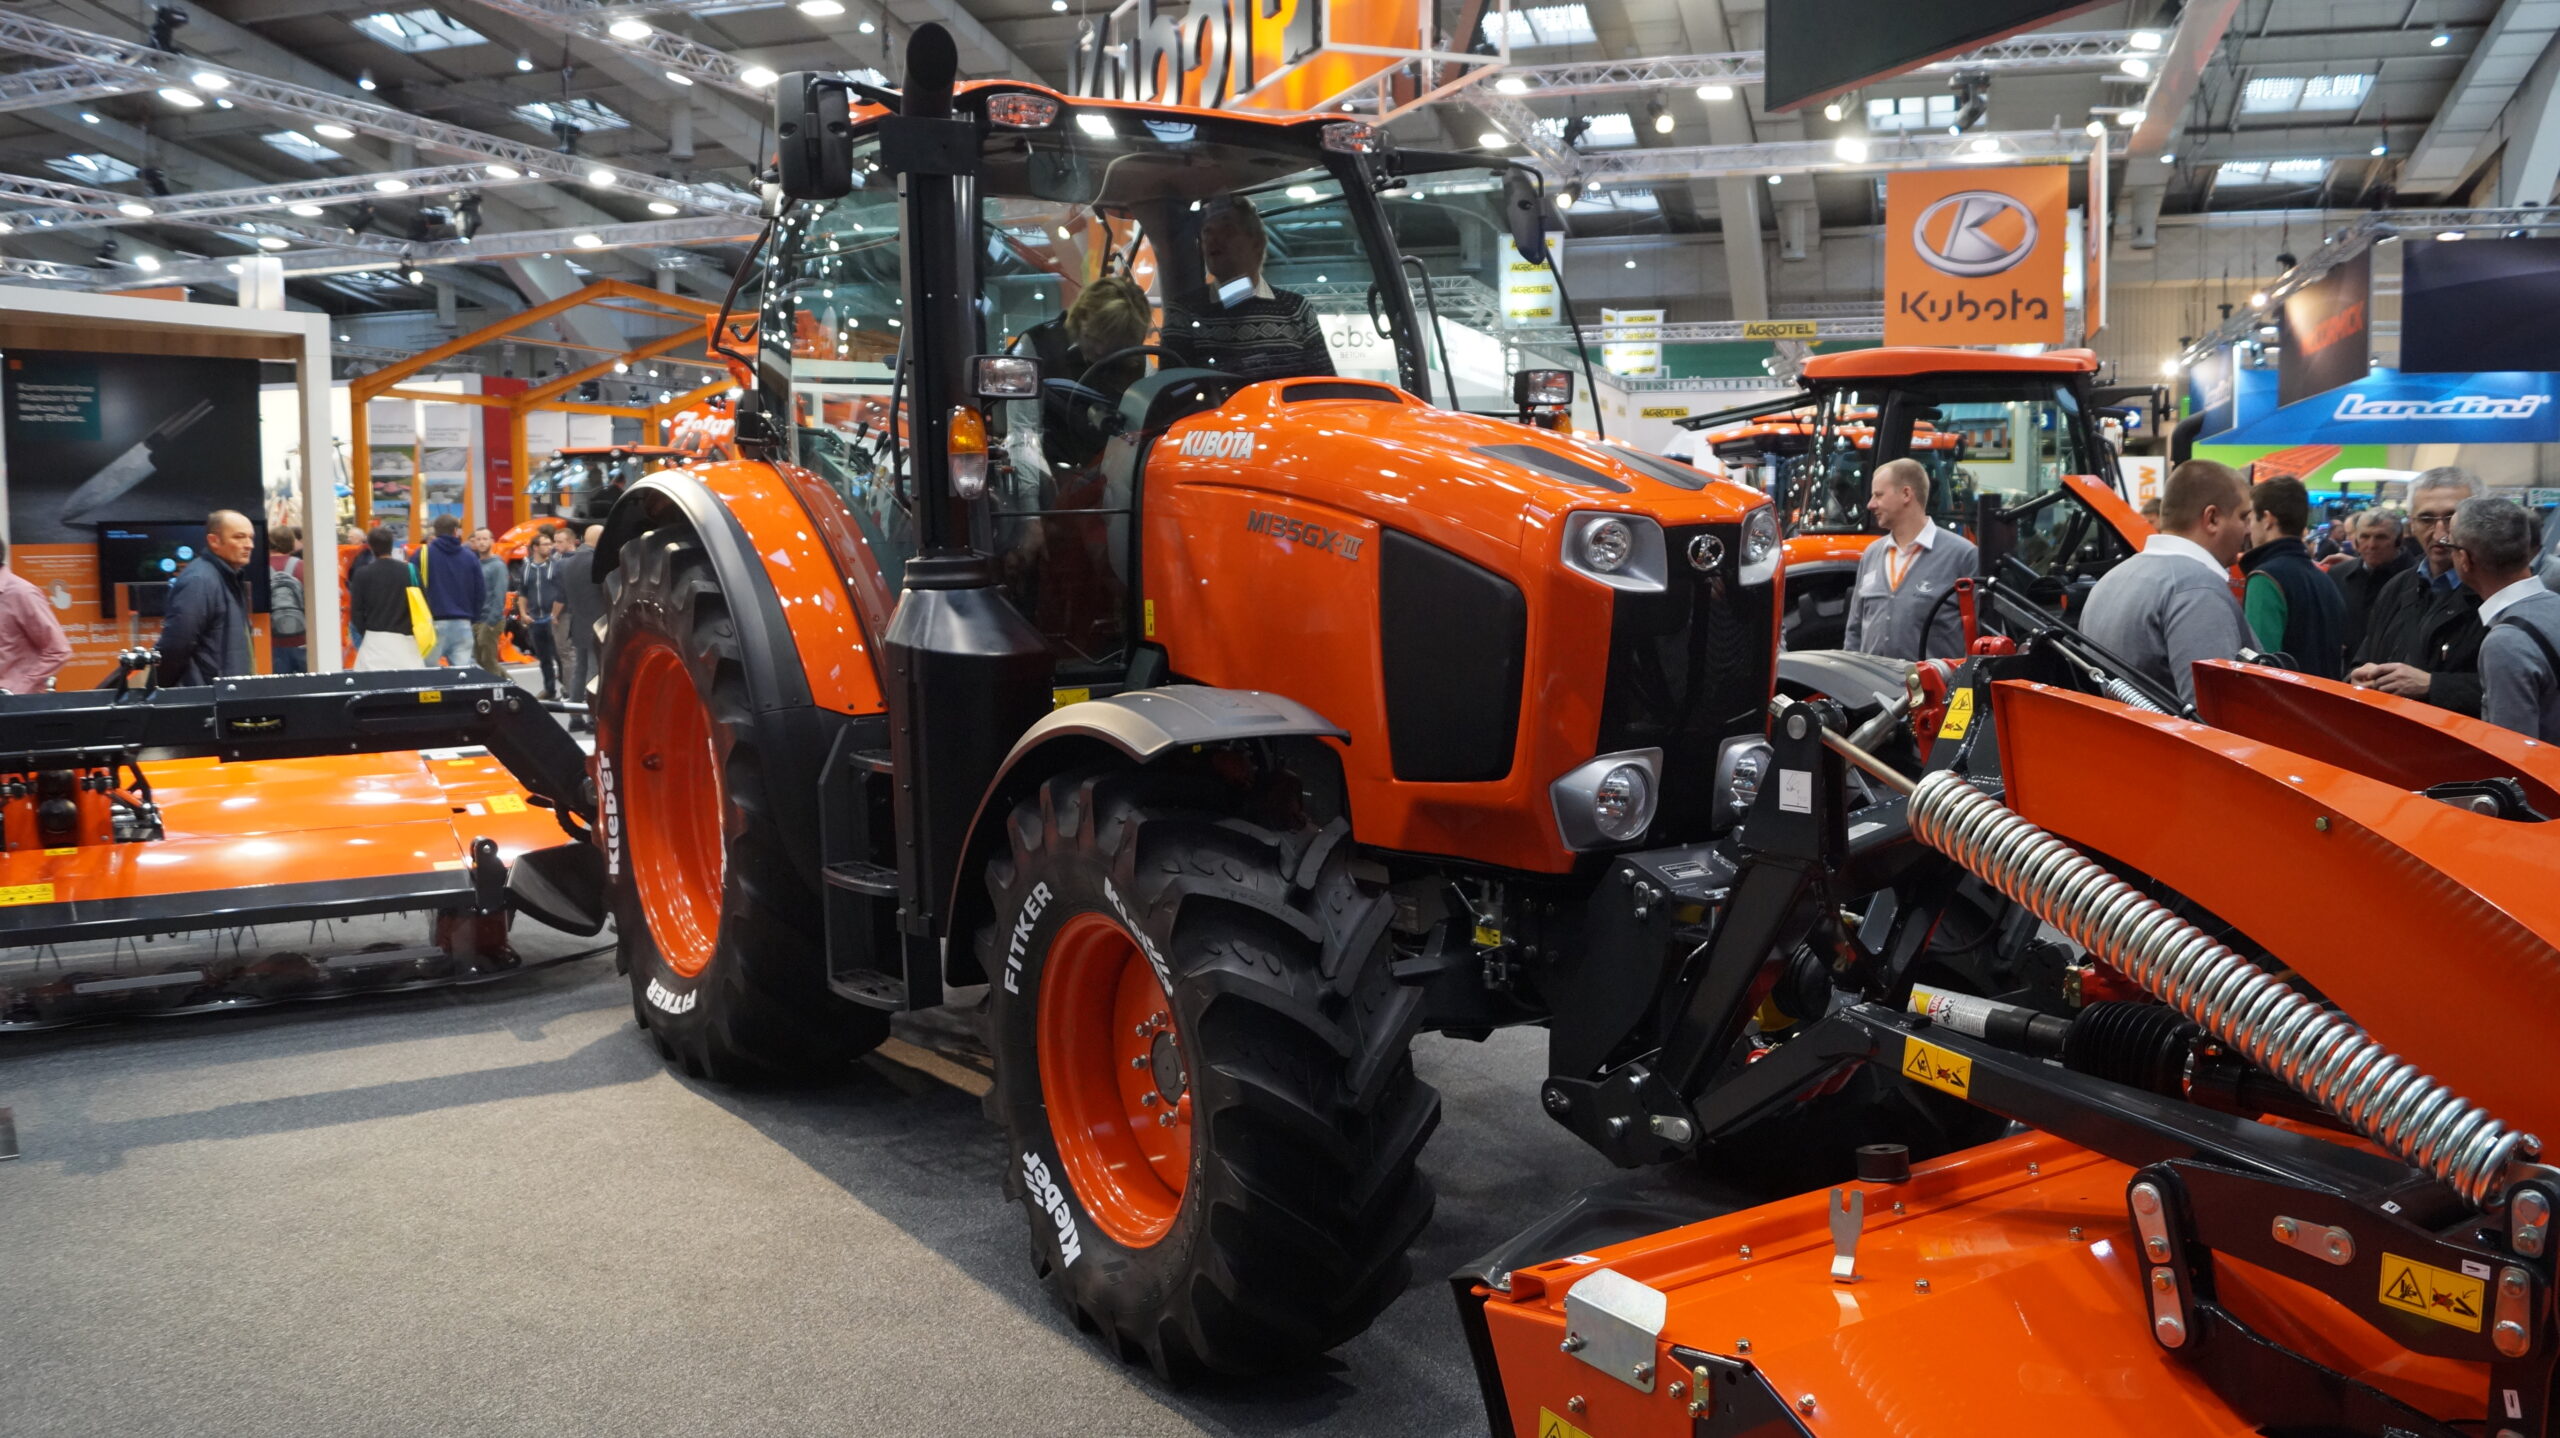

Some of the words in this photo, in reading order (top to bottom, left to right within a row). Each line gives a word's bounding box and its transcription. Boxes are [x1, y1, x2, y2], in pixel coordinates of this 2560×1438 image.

[1901, 289, 2049, 322] Kubota
[1330, 325, 1375, 348] cbs
[1745, 323, 1814, 337] AGROTEL
[1642, 408, 1687, 417] AGROTEL
[2333, 393, 2542, 420] Landini
[1179, 430, 1255, 459] KUBOTA
[599, 751, 620, 875] Kleber
[1004, 881, 1054, 995] FITKER
[646, 977, 697, 1015] FITKER
[1022, 1151, 1081, 1268] Kleber
